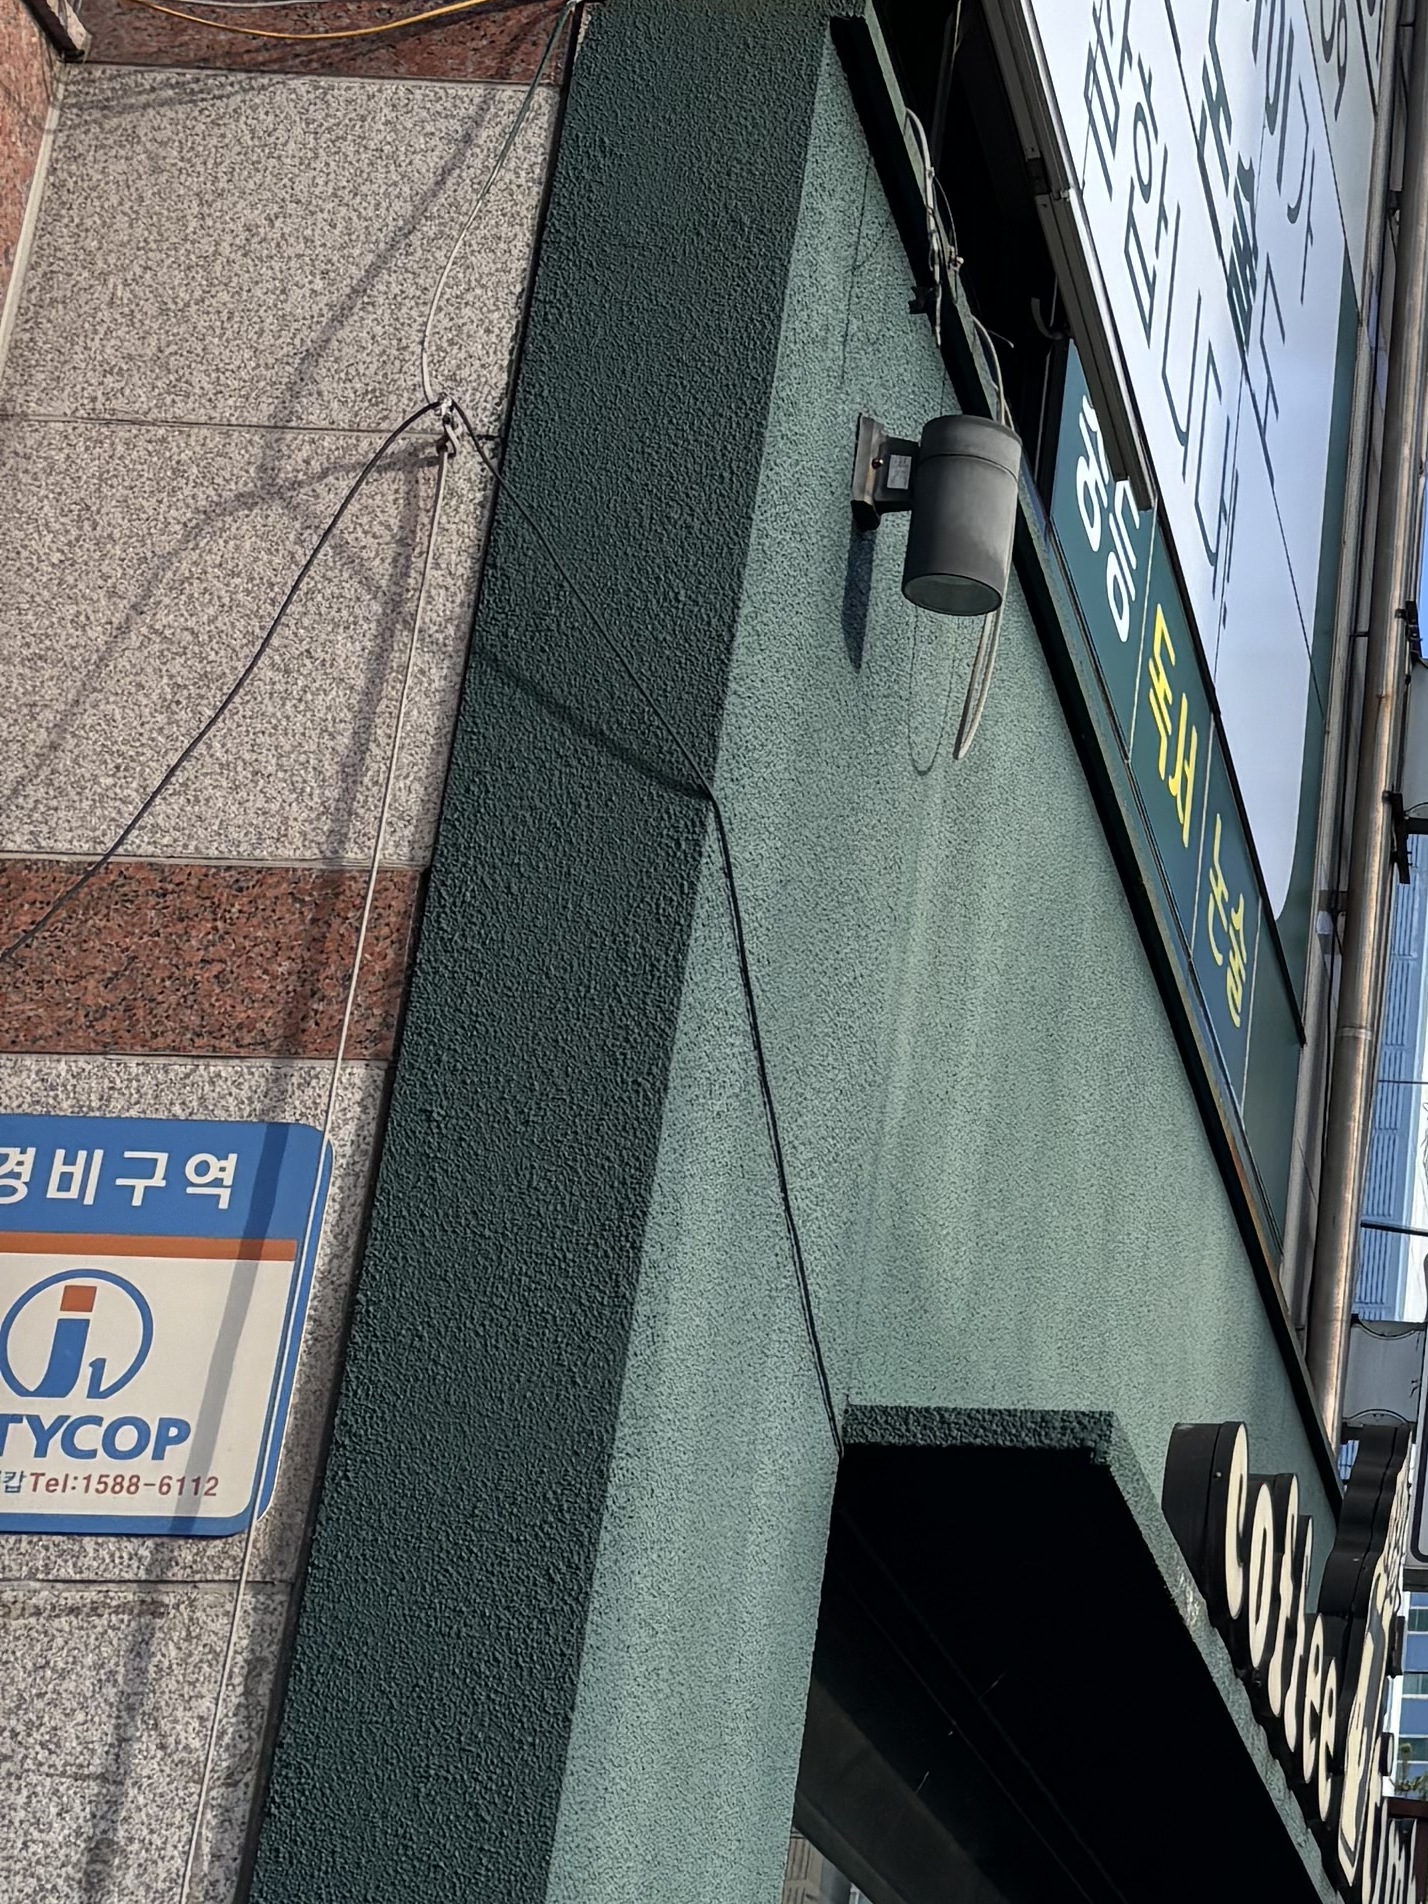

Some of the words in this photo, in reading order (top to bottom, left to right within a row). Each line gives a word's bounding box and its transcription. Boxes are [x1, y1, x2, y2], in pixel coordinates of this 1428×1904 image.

[1149, 606, 1196, 845] 독서
[1208, 815, 1245, 1025] 논술
[0, 1146, 239, 1210] 경비구역
[1225, 1422, 1338, 1823] coffee
